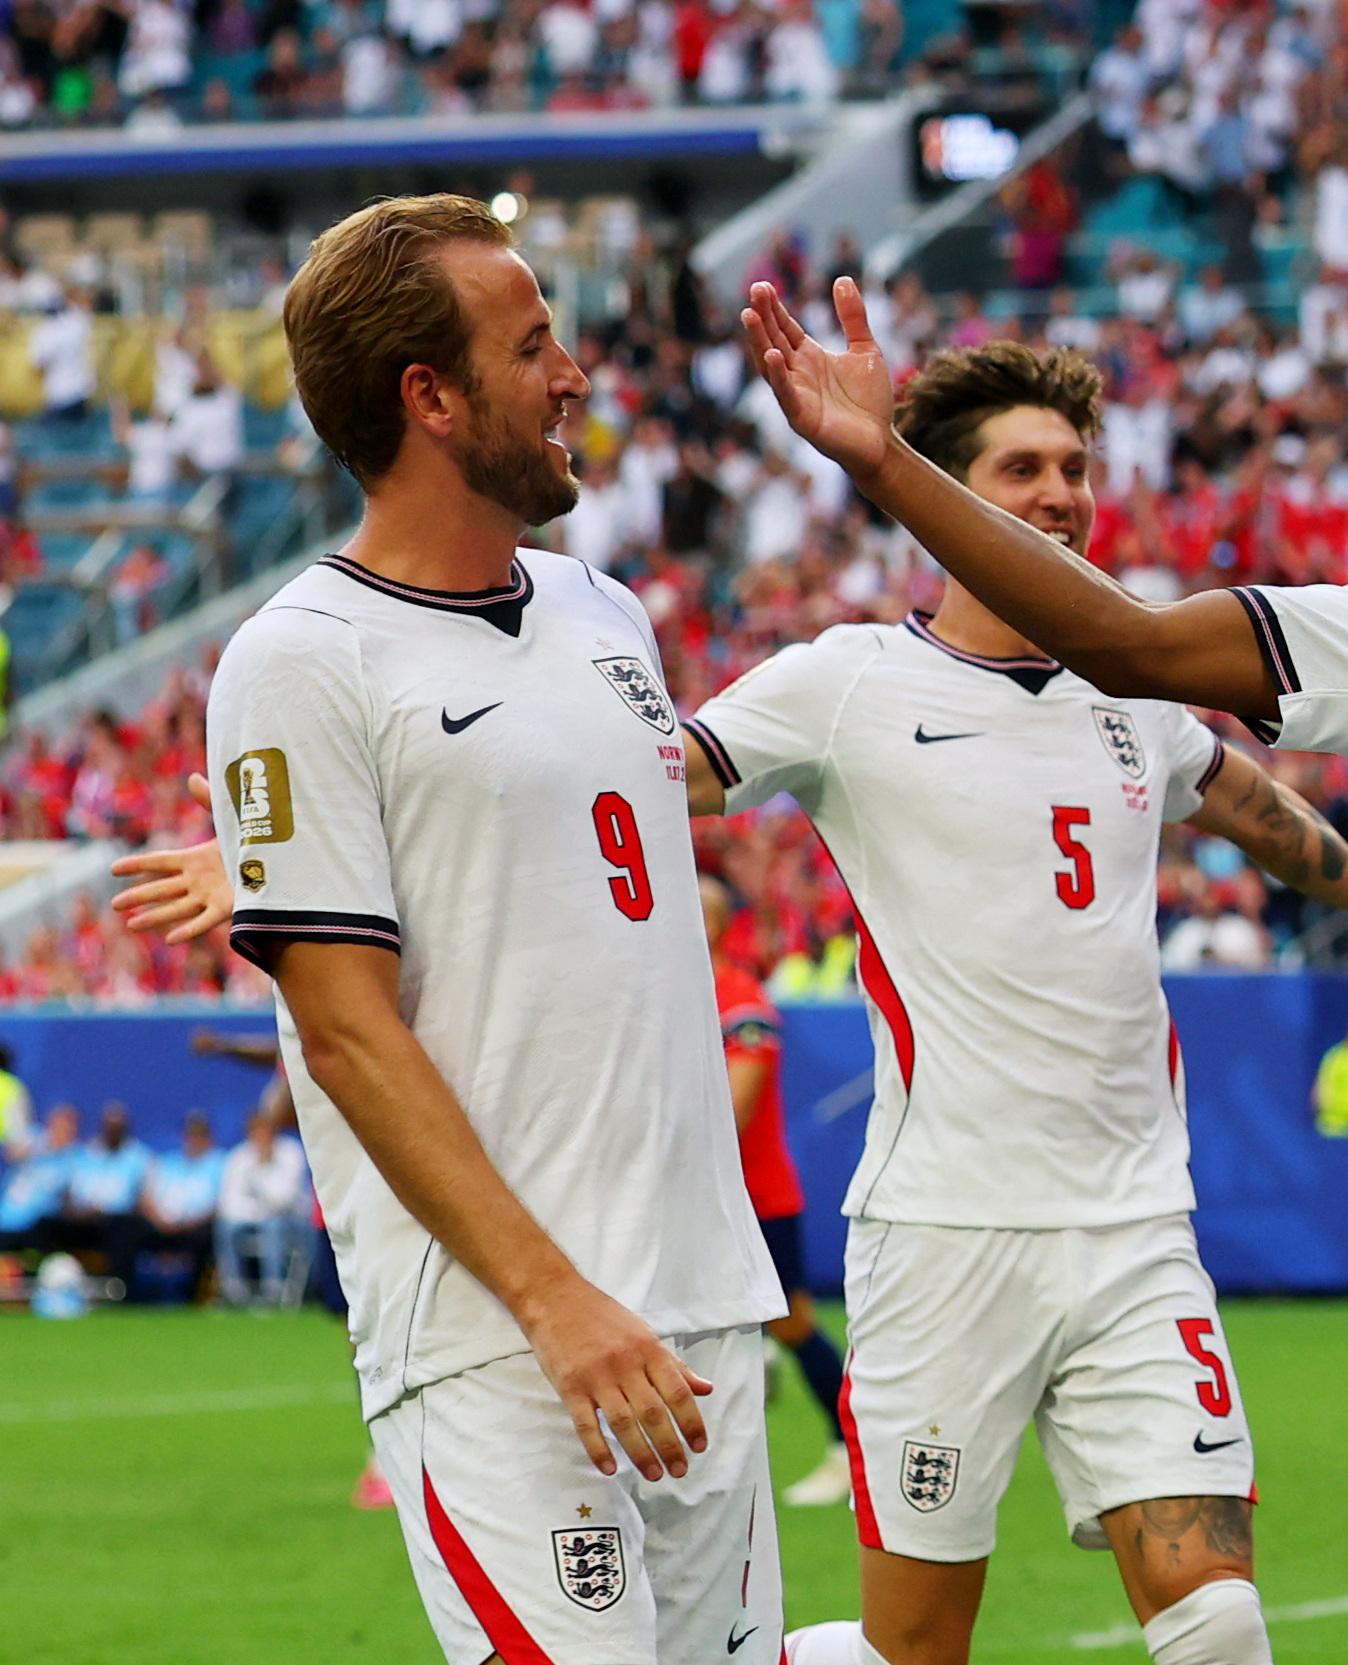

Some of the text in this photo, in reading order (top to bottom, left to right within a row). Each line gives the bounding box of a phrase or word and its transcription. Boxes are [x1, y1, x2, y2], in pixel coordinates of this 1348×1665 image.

[591, 791, 654, 921] 9
[1051, 805, 1095, 909] 5
[1175, 1317, 1232, 1417] 5
